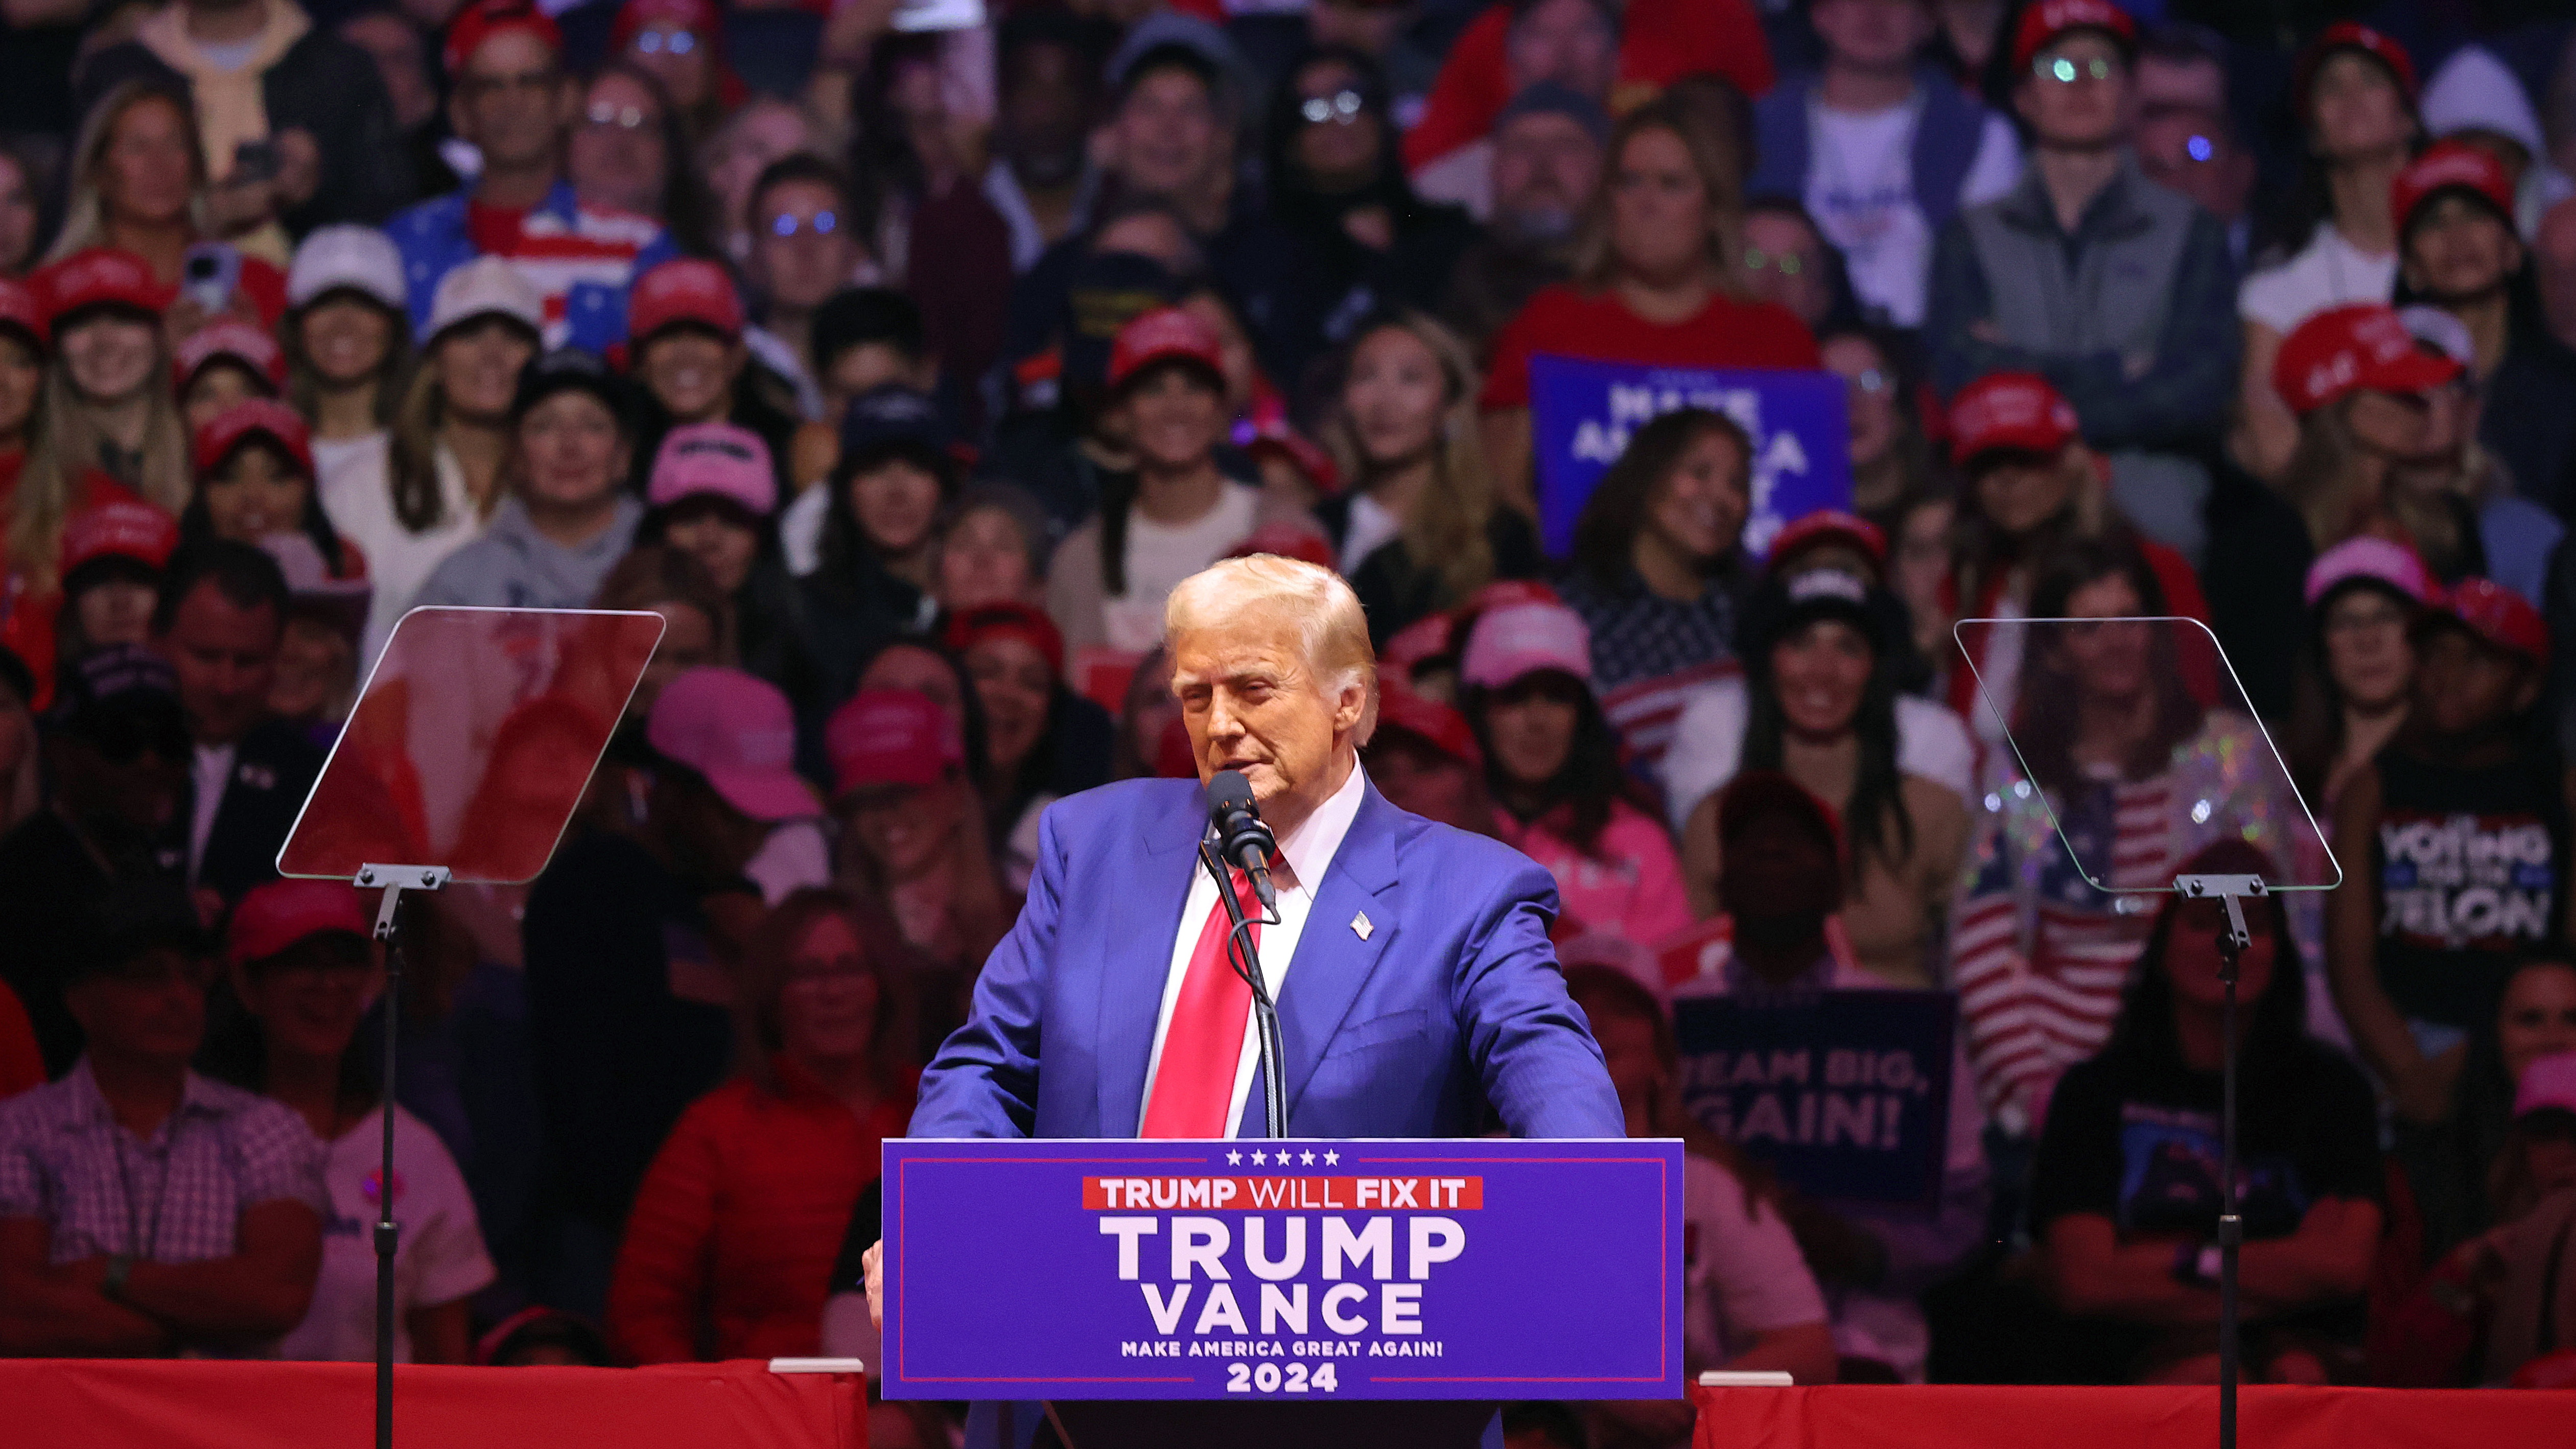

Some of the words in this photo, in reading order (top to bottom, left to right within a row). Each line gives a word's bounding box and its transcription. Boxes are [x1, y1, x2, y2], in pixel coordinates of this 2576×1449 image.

[1825, 1047, 1930, 1097] BIG,
[1100, 1179, 1237, 1208] TRUMP
[1248, 1179, 1344, 1208] WILL
[1357, 1179, 1419, 1208] FIX
[1431, 1179, 1466, 1208] IT
[1100, 1217, 1466, 1280] TRUMP
[1141, 1283, 1423, 1335] VANCE
[1122, 1341, 1181, 1357] MAKE
[1189, 1341, 1284, 1357] AMERICA
[1293, 1341, 1361, 1357] GREAT
[1369, 1341, 1443, 1357] AGAIN!
[1227, 1363, 1338, 1393] 2024
